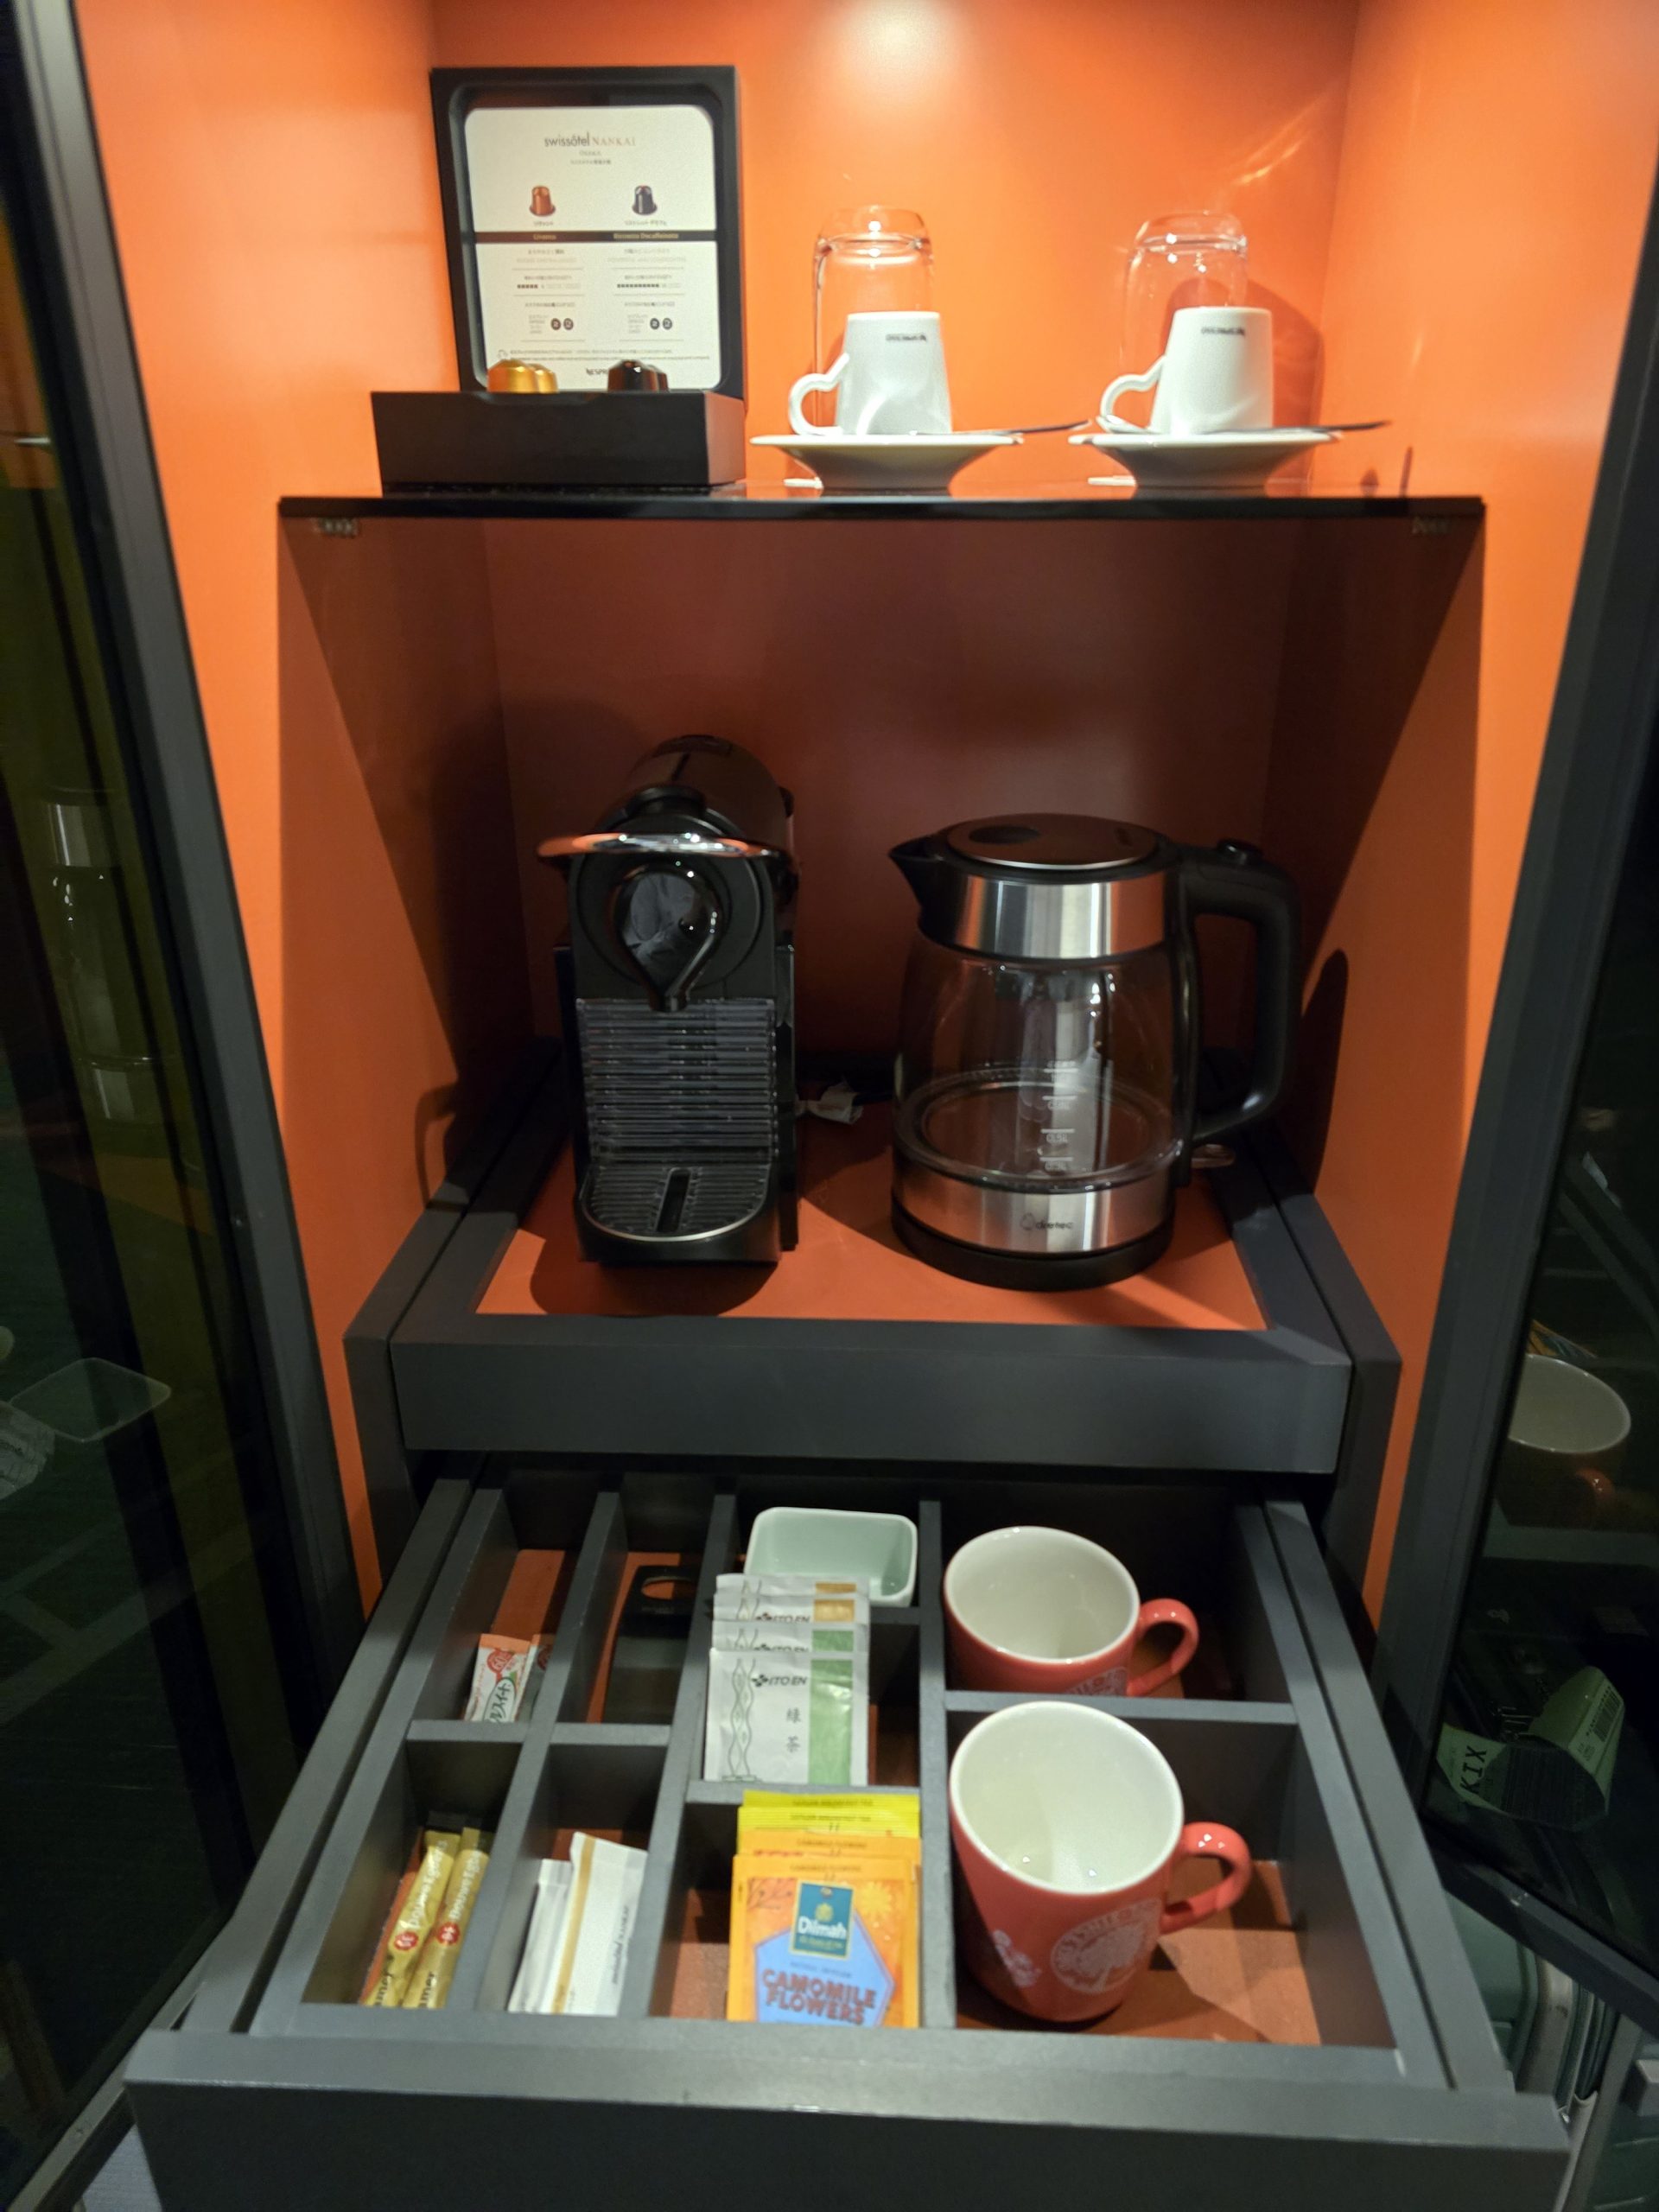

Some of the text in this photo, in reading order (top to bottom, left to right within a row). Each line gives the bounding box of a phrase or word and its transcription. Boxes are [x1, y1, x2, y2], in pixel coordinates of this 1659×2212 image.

[768, 1675, 808, 1686] ITO EN
[761, 1968, 878, 2010] CAMOMILE
[766, 1989, 866, 2025] FLOWERS
